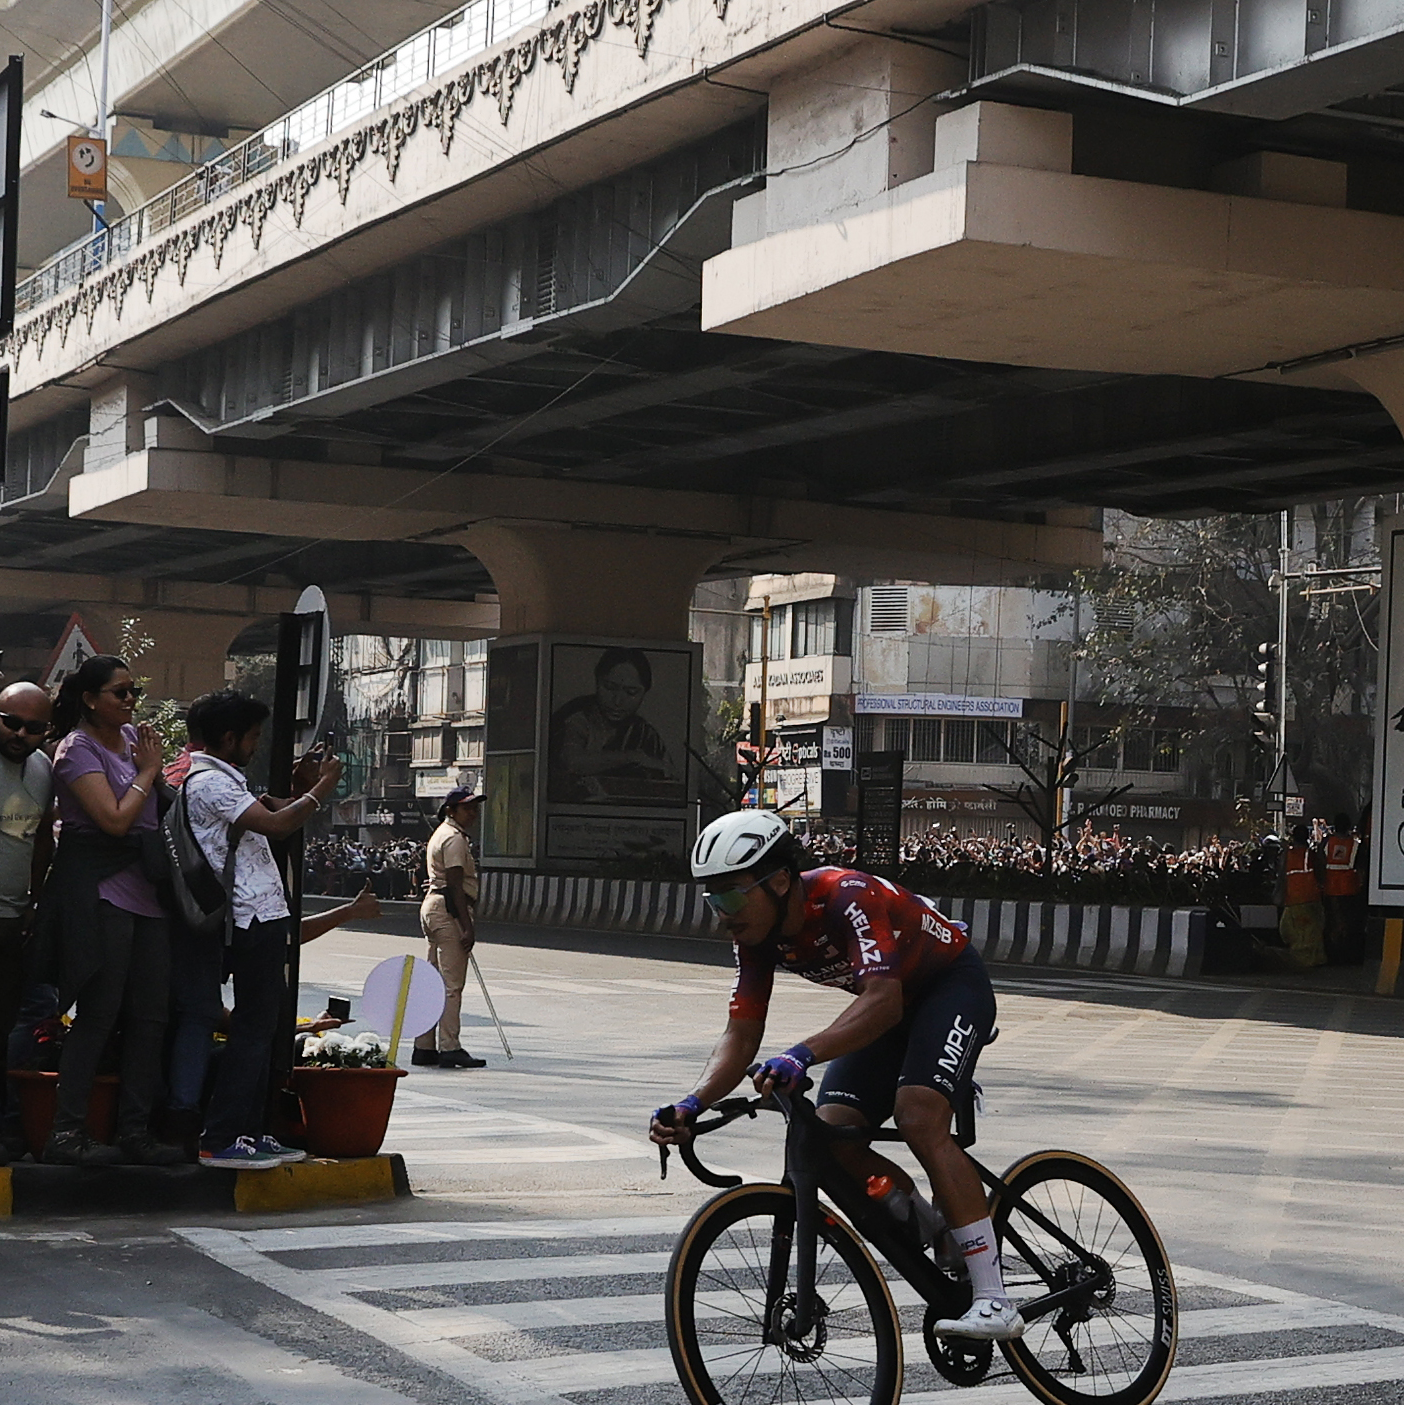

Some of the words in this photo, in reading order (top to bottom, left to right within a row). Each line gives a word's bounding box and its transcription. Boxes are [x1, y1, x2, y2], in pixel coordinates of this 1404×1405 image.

[897, 698, 937, 712] STRUCTURAL
[936, 699, 975, 713] ENGINEERS
[975, 700, 1020, 715] ASSOCIATION
[833, 746, 851, 759] 500
[1130, 804, 1181, 820] PHARMACY
[844, 901, 883, 965] HELAZ
[921, 912, 953, 944] MZSB
[937, 1014, 974, 1075] MPC
[960, 1235, 987, 1251] PC
[1156, 1268, 1174, 1317] SWISS
[1160, 1318, 1174, 1349] DT
